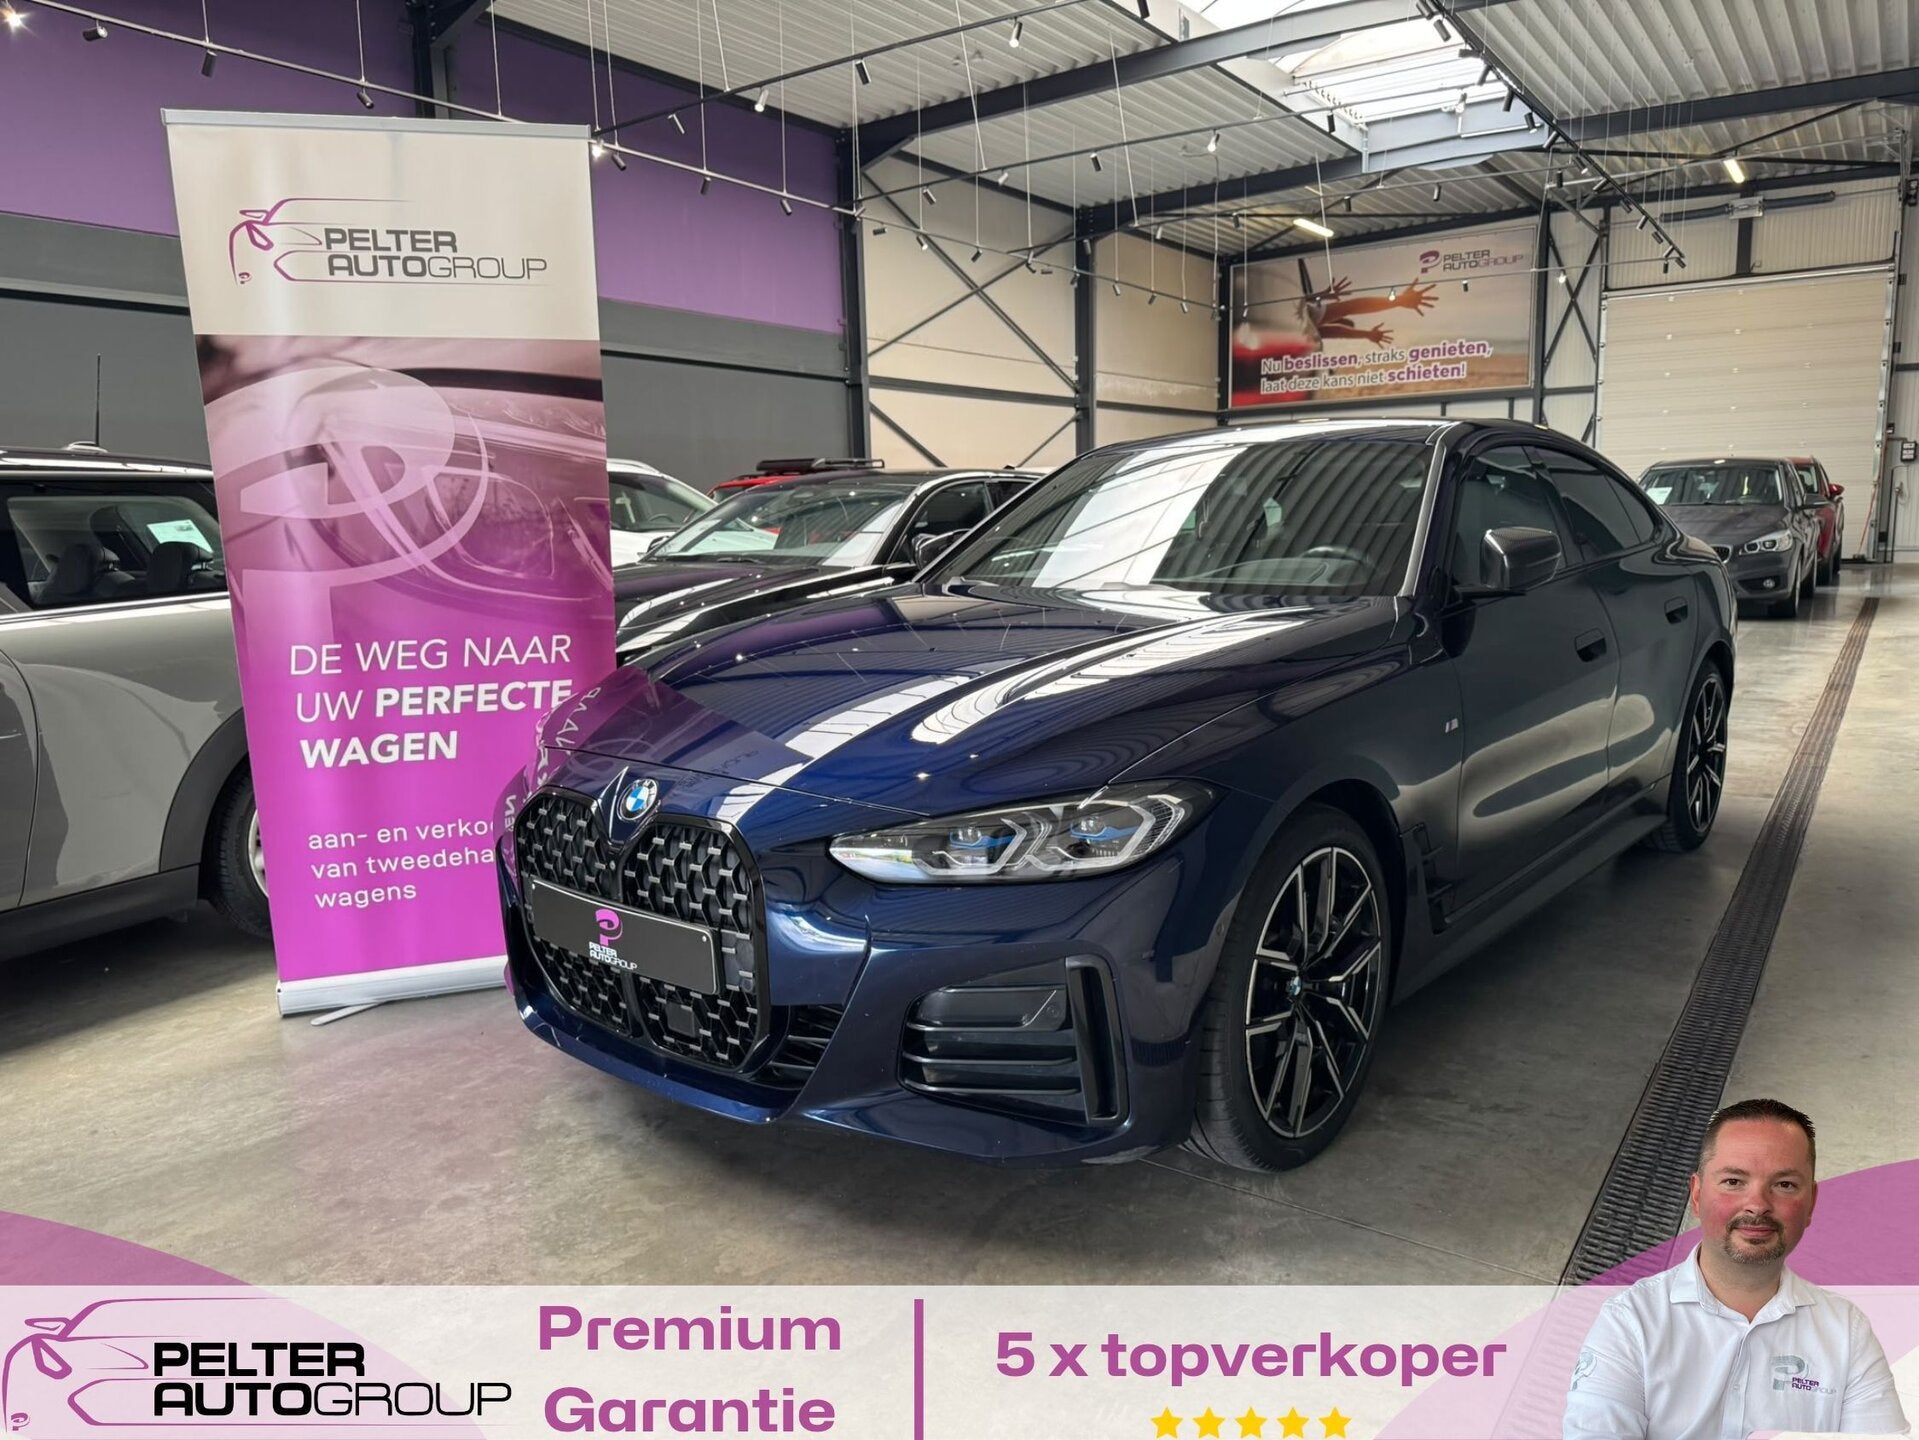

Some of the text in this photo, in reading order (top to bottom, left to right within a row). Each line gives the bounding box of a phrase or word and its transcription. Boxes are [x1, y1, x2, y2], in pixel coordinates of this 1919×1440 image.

[324, 227, 458, 253] PELTER
[327, 254, 548, 280] AUTOGROUP
[1443, 249, 1491, 262] PELTER
[1443, 254, 1524, 272] AUTOGROUP
[1261, 341, 1493, 374] Nu beslissen, straks genieten,
[1261, 363, 1466, 393] laat deze kans niet schieten!
[289, 634, 572, 675] DE WEG NAAR
[296, 679, 573, 723] UW PERFECTE
[299, 730, 458, 769] WAGEN
[308, 818, 494, 850] aan- en verko
[311, 861, 358, 879] van
[315, 883, 417, 909] wagens
[588, 941, 618, 958] PELTER
[589, 949, 638, 971] AUTOGROUP
[1791, 1376, 1820, 1387] PELTER
